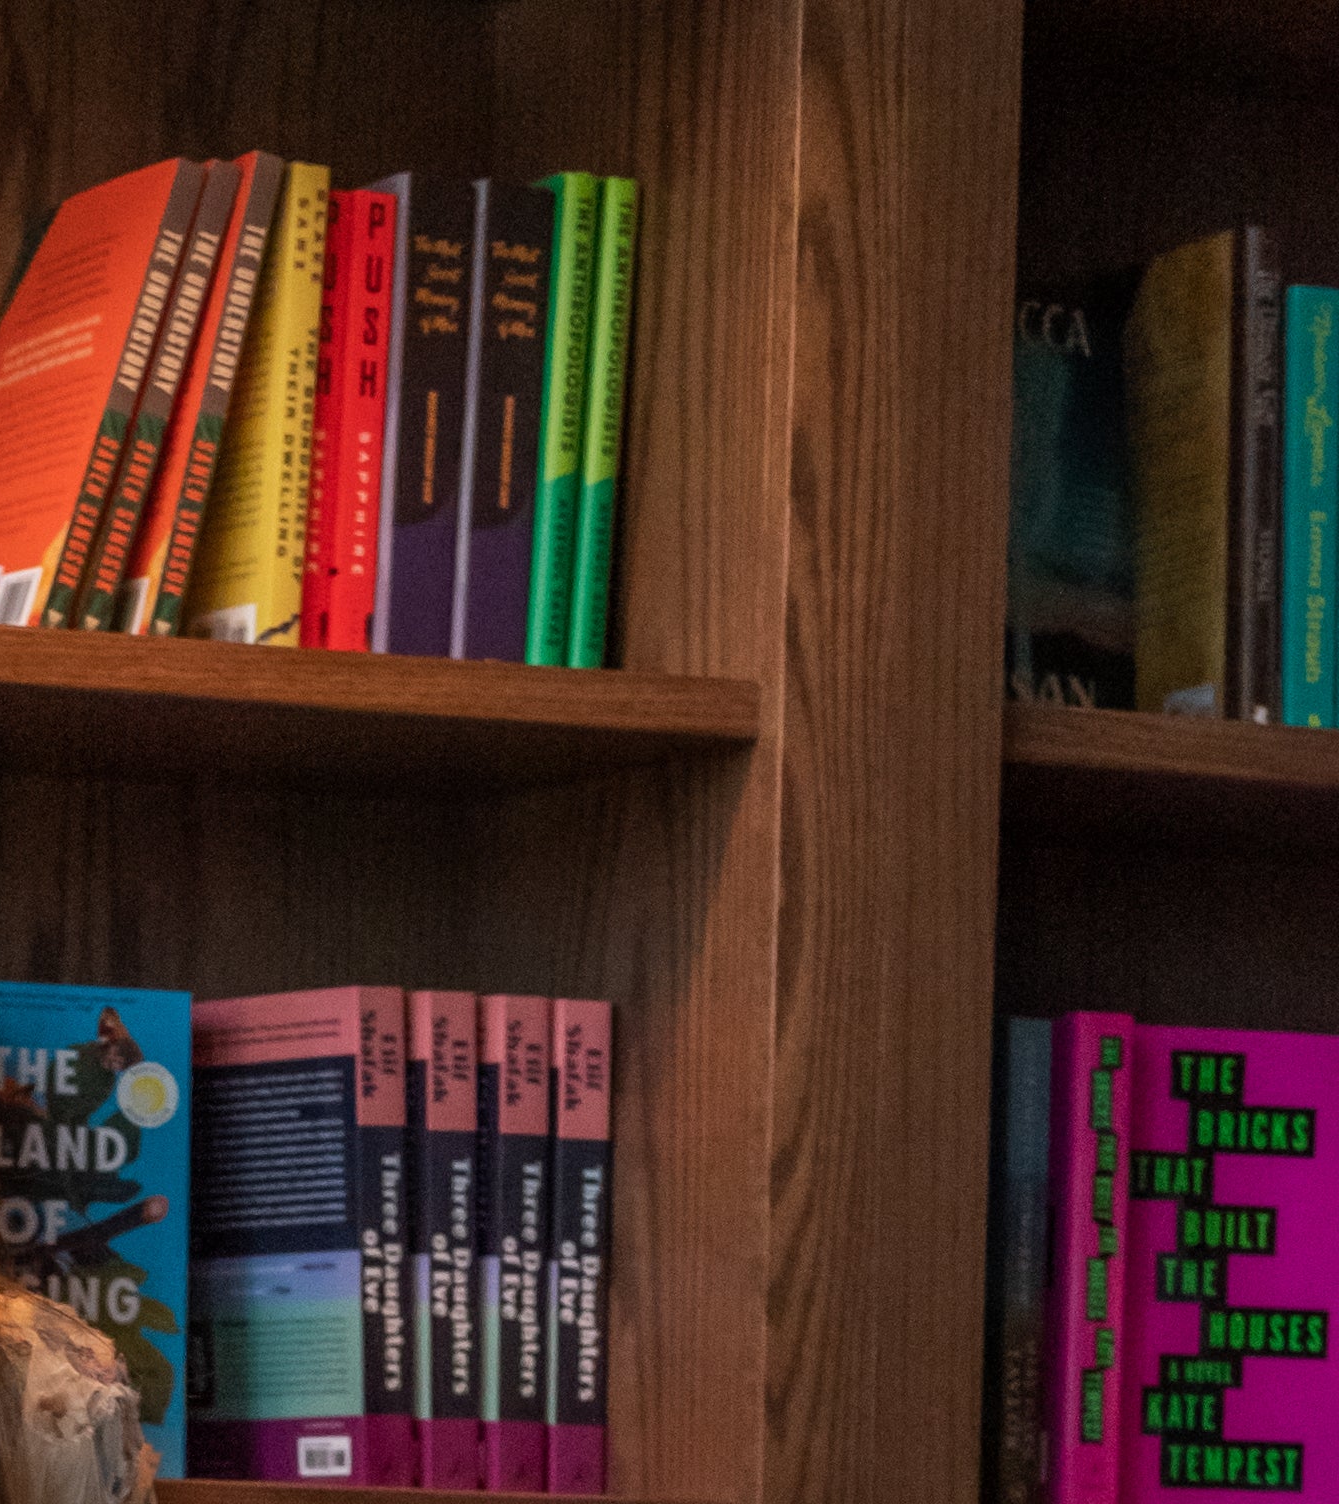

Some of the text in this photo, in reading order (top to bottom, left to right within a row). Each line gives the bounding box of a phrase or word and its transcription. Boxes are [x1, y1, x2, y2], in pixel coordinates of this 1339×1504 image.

[350, 201, 386, 576] PUSH SAPPHIRE
[1179, 1055, 1236, 1094] THE
[1197, 1110, 1310, 1152] BRICKS
[1135, 1154, 1206, 1196] THAT
[1183, 1209, 1270, 1249] BUILT
[559, 1240, 577, 1326] of Eve
[576, 1166, 602, 1402] Three Daughters
[1164, 1257, 1218, 1297] THE
[1209, 1311, 1323, 1352] HOUSES
[1147, 1393, 1216, 1432] KATE
[1167, 1445, 1299, 1485] TEMPEST
